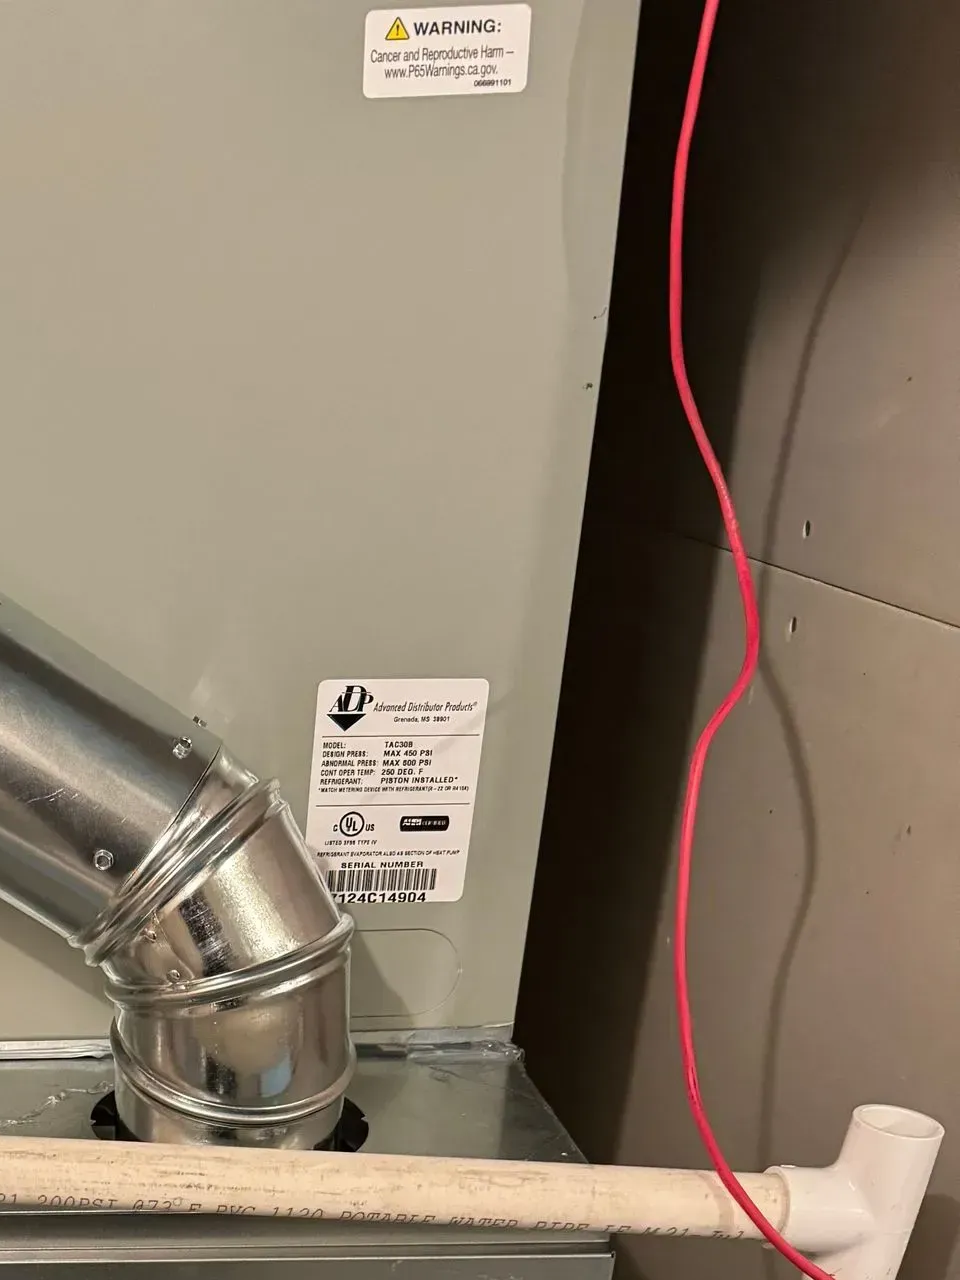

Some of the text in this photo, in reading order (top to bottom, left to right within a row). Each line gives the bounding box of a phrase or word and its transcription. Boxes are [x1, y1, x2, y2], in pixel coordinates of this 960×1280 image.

[413, 19, 502, 36] WARNING:
[370, 45, 504, 63] Cancer and Reproductive Harm
[384, 63, 498, 79] www.P65Warnings.ca.gov.
[373, 702, 407, 712] Advanced
[407, 702, 443, 712] Distributor
[322, 741, 346, 749] MODEL:
